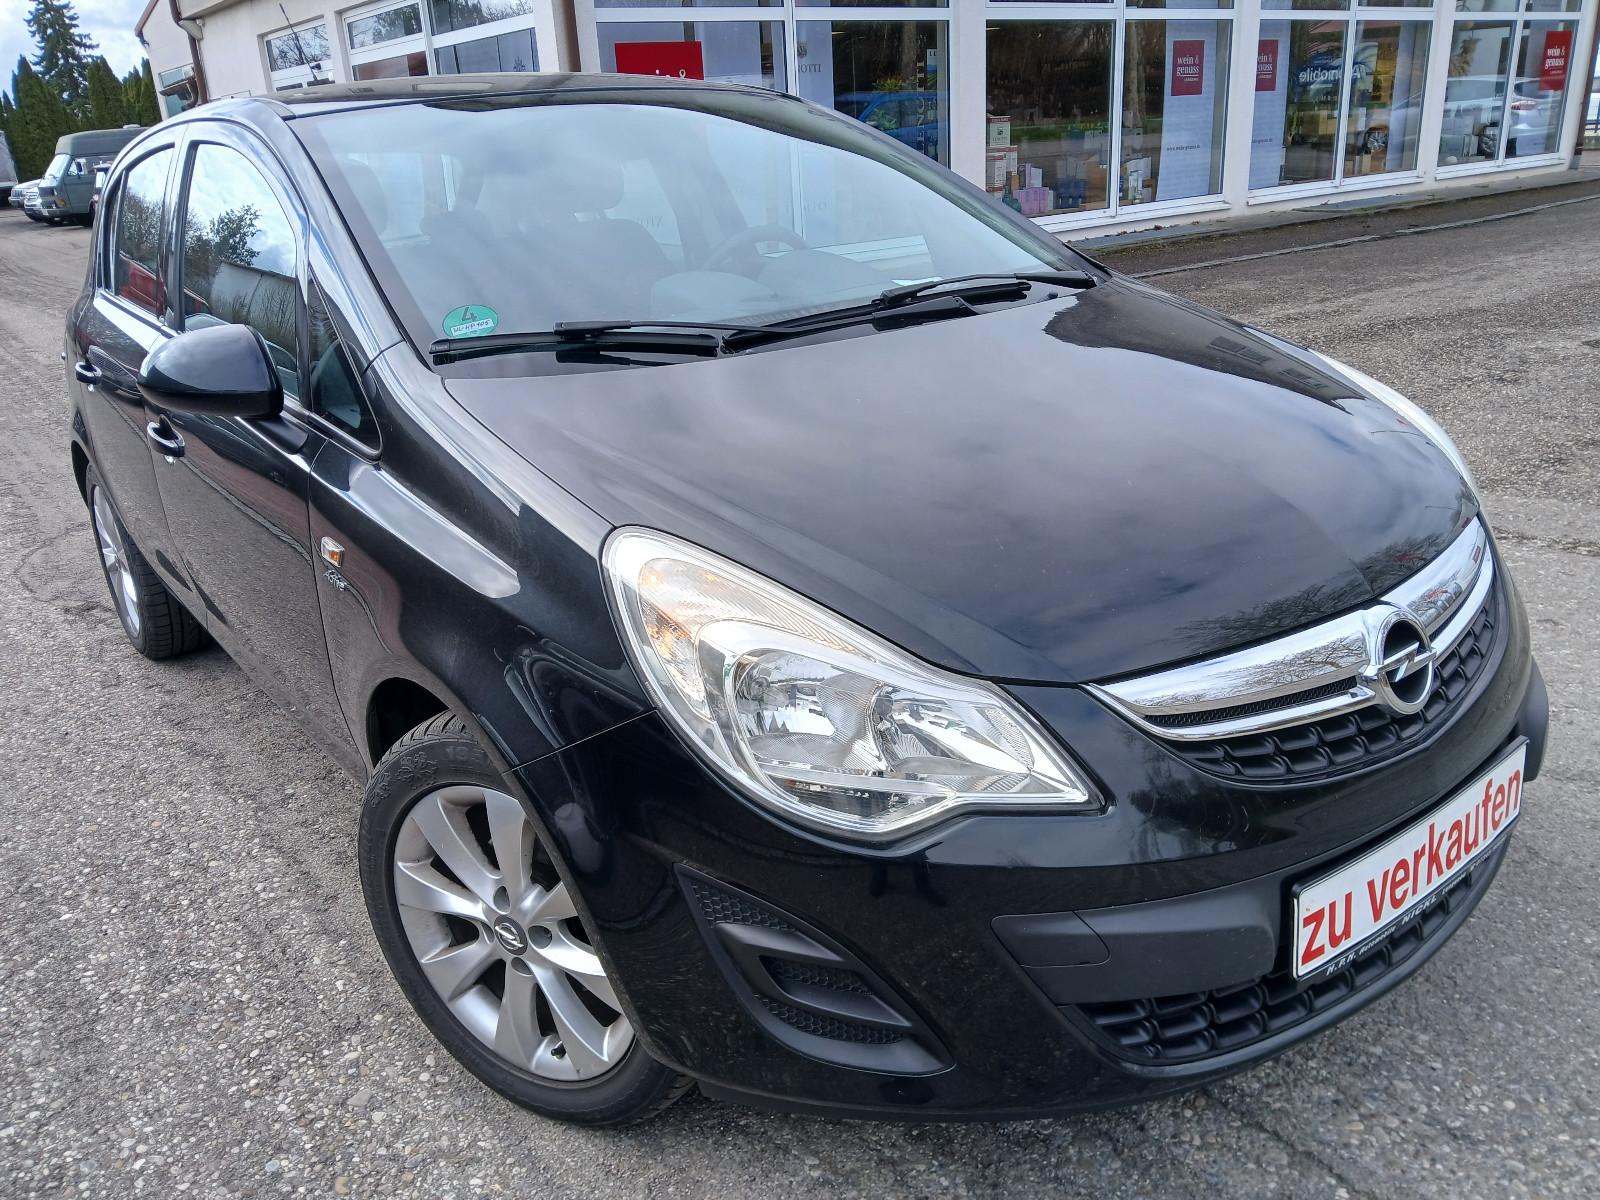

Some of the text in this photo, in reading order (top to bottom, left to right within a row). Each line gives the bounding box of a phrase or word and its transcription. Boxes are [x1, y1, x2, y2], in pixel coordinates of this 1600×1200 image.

[1547, 45, 1560, 56] wein
[1177, 54, 1194, 65] wein
[1257, 53, 1268, 62] ein
[1257, 63, 1273, 71] nuss
[1545, 58, 1565, 69] genuss
[1176, 66, 1200, 76] genuss
[461, 306, 478, 322] 4
[1301, 768, 1521, 966] zu verkaufen
